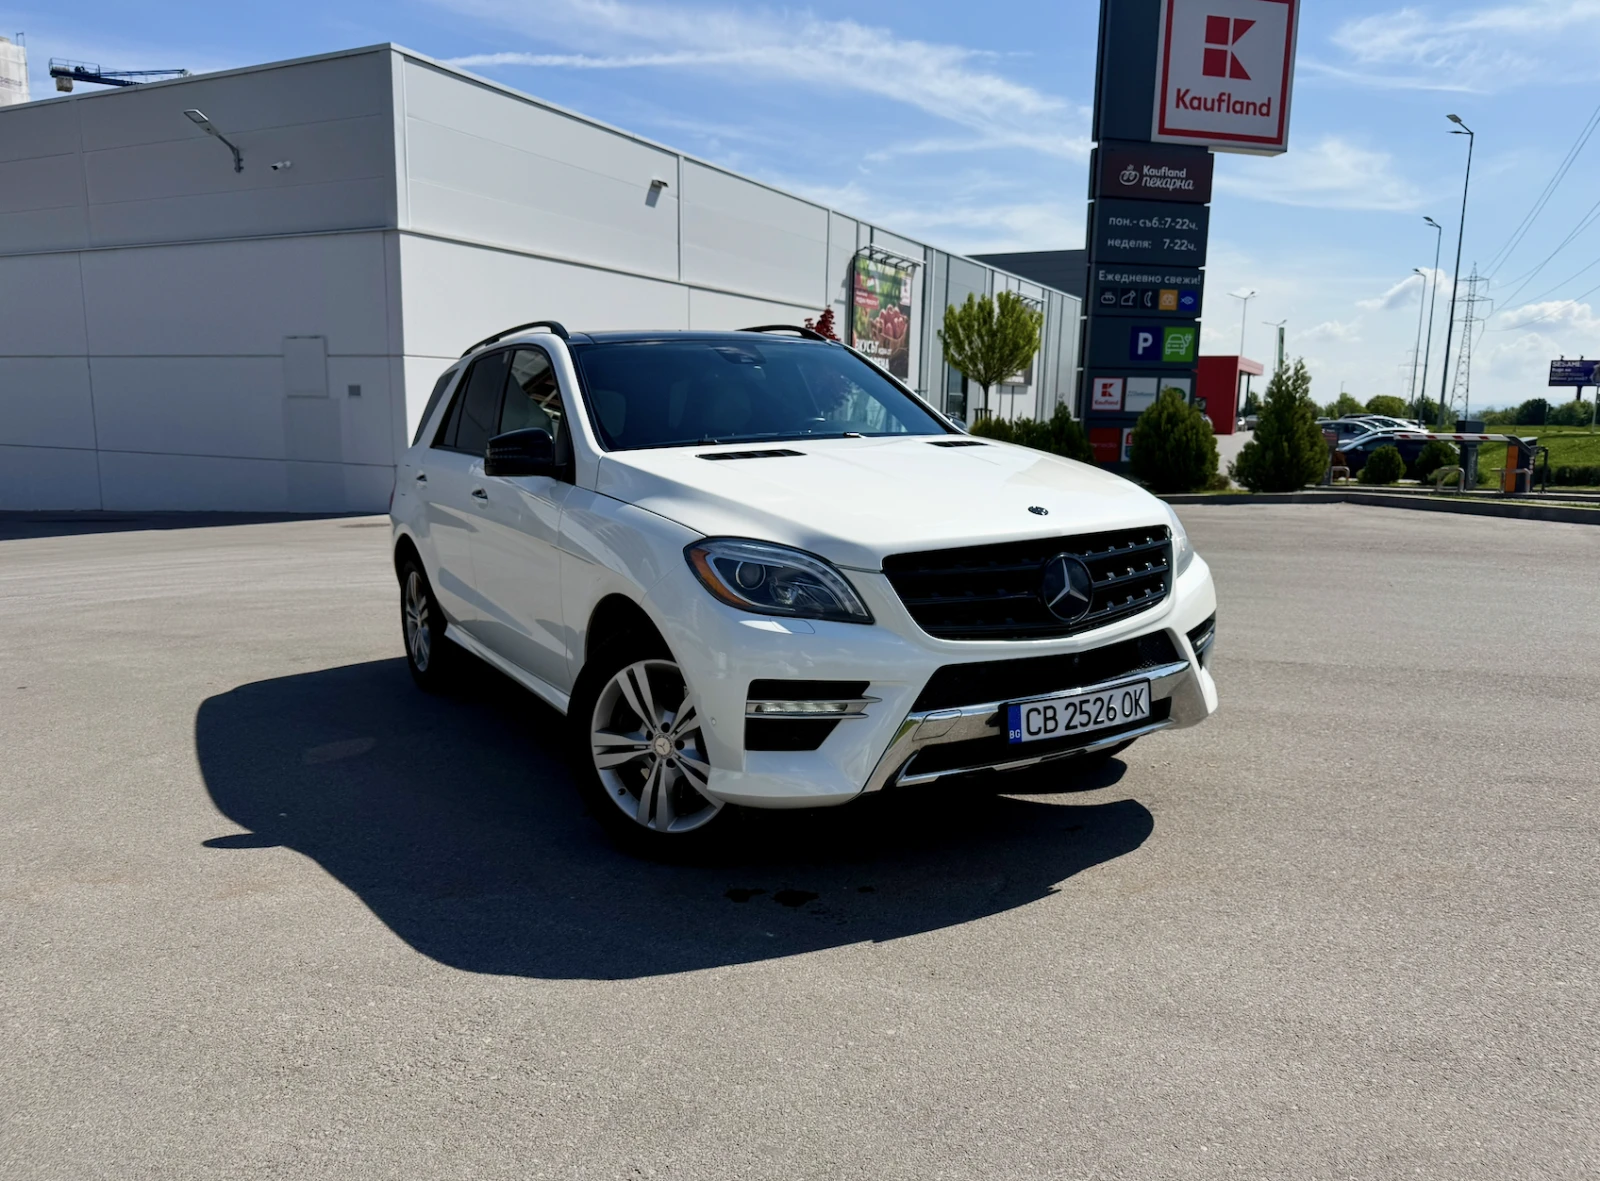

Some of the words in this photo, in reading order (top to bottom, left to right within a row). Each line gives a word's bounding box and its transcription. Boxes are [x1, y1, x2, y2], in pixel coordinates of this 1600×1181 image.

[1175, 88, 1272, 117] Kaufland
[1142, 165, 1187, 178] Kaufland
[1141, 176, 1194, 191] пекарна
[1098, 270, 1162, 283] Ежедневно
[1164, 274, 1201, 285] свежи!
[1137, 332, 1153, 355] P
[1026, 705, 1058, 736] CB
[1064, 694, 1117, 731] 2526
[1121, 687, 1146, 718] OK
[1009, 729, 1021, 739] BG
